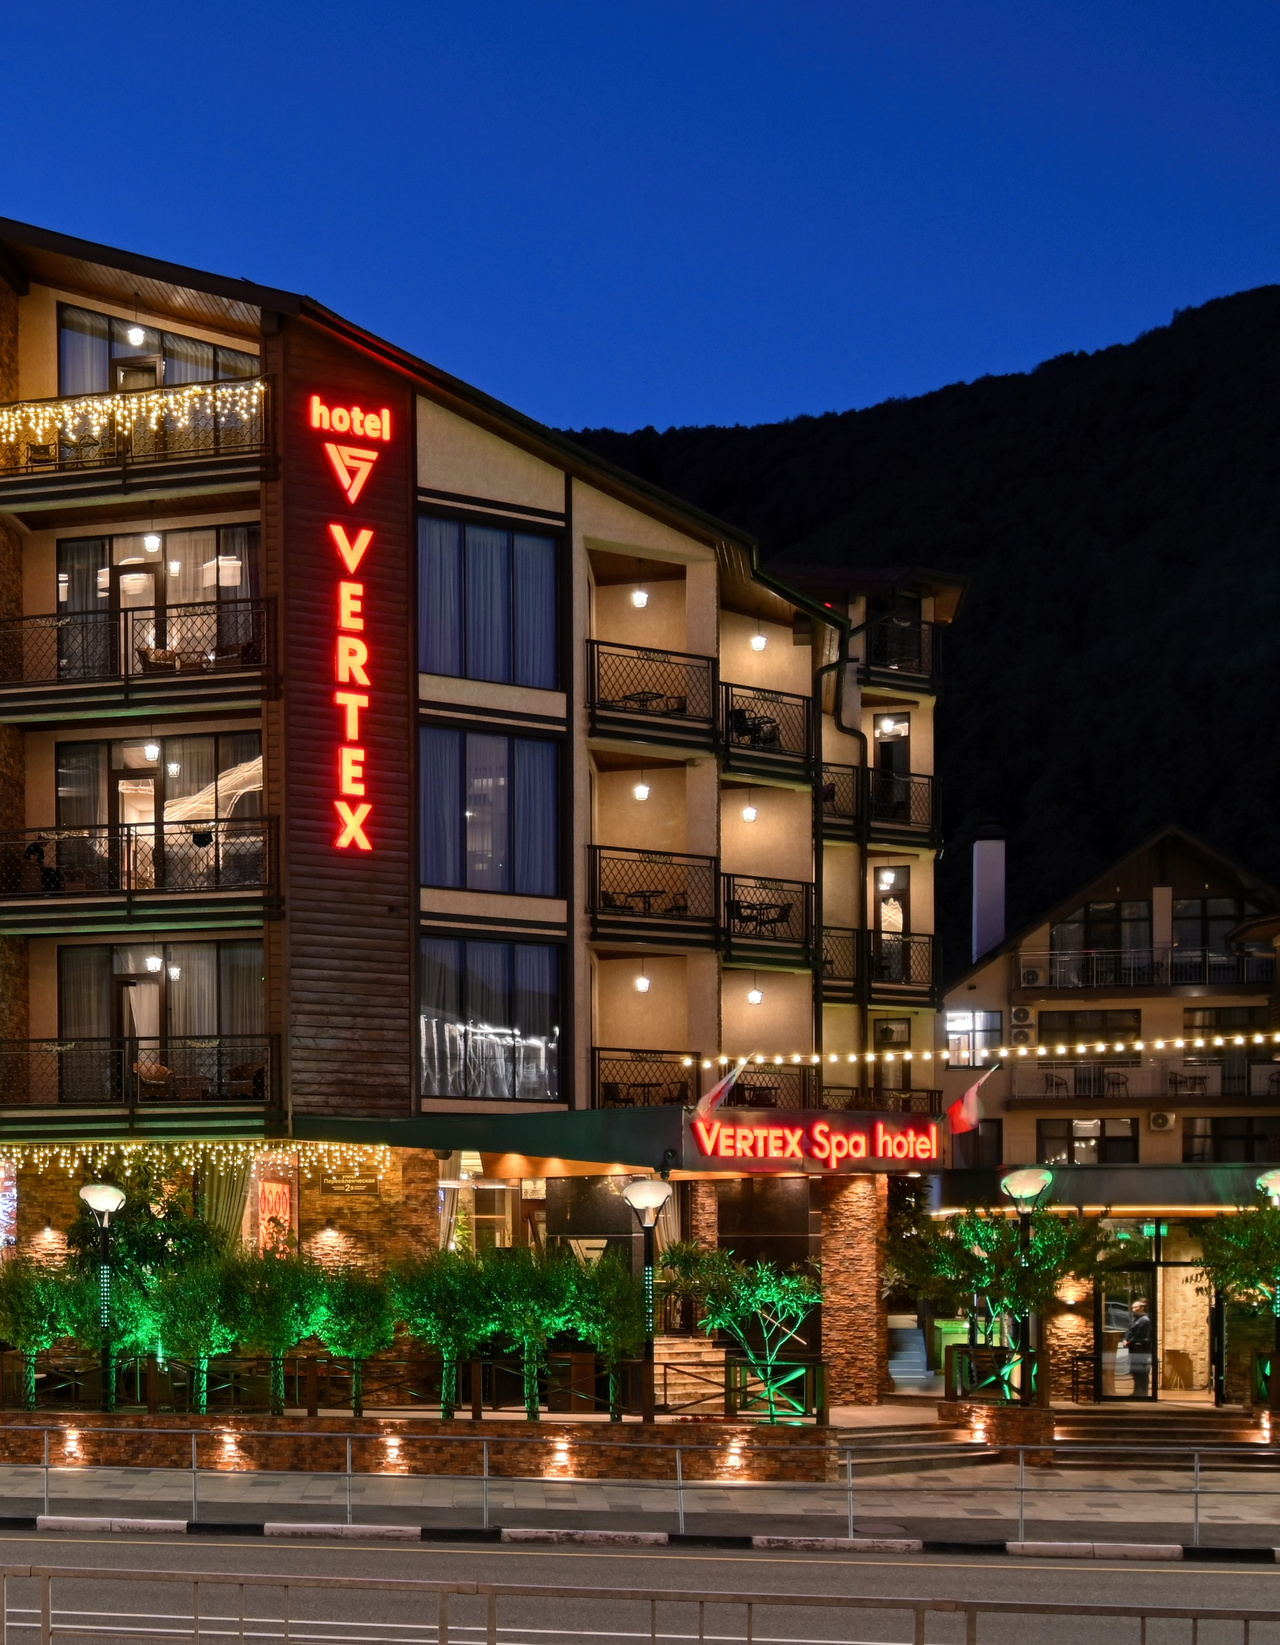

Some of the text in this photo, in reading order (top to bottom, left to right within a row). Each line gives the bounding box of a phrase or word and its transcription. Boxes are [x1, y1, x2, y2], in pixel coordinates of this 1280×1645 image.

[311, 396, 391, 441] hotel
[330, 524, 374, 851] VERTEX
[696, 1121, 938, 1169] VERTEX Spa hotel
